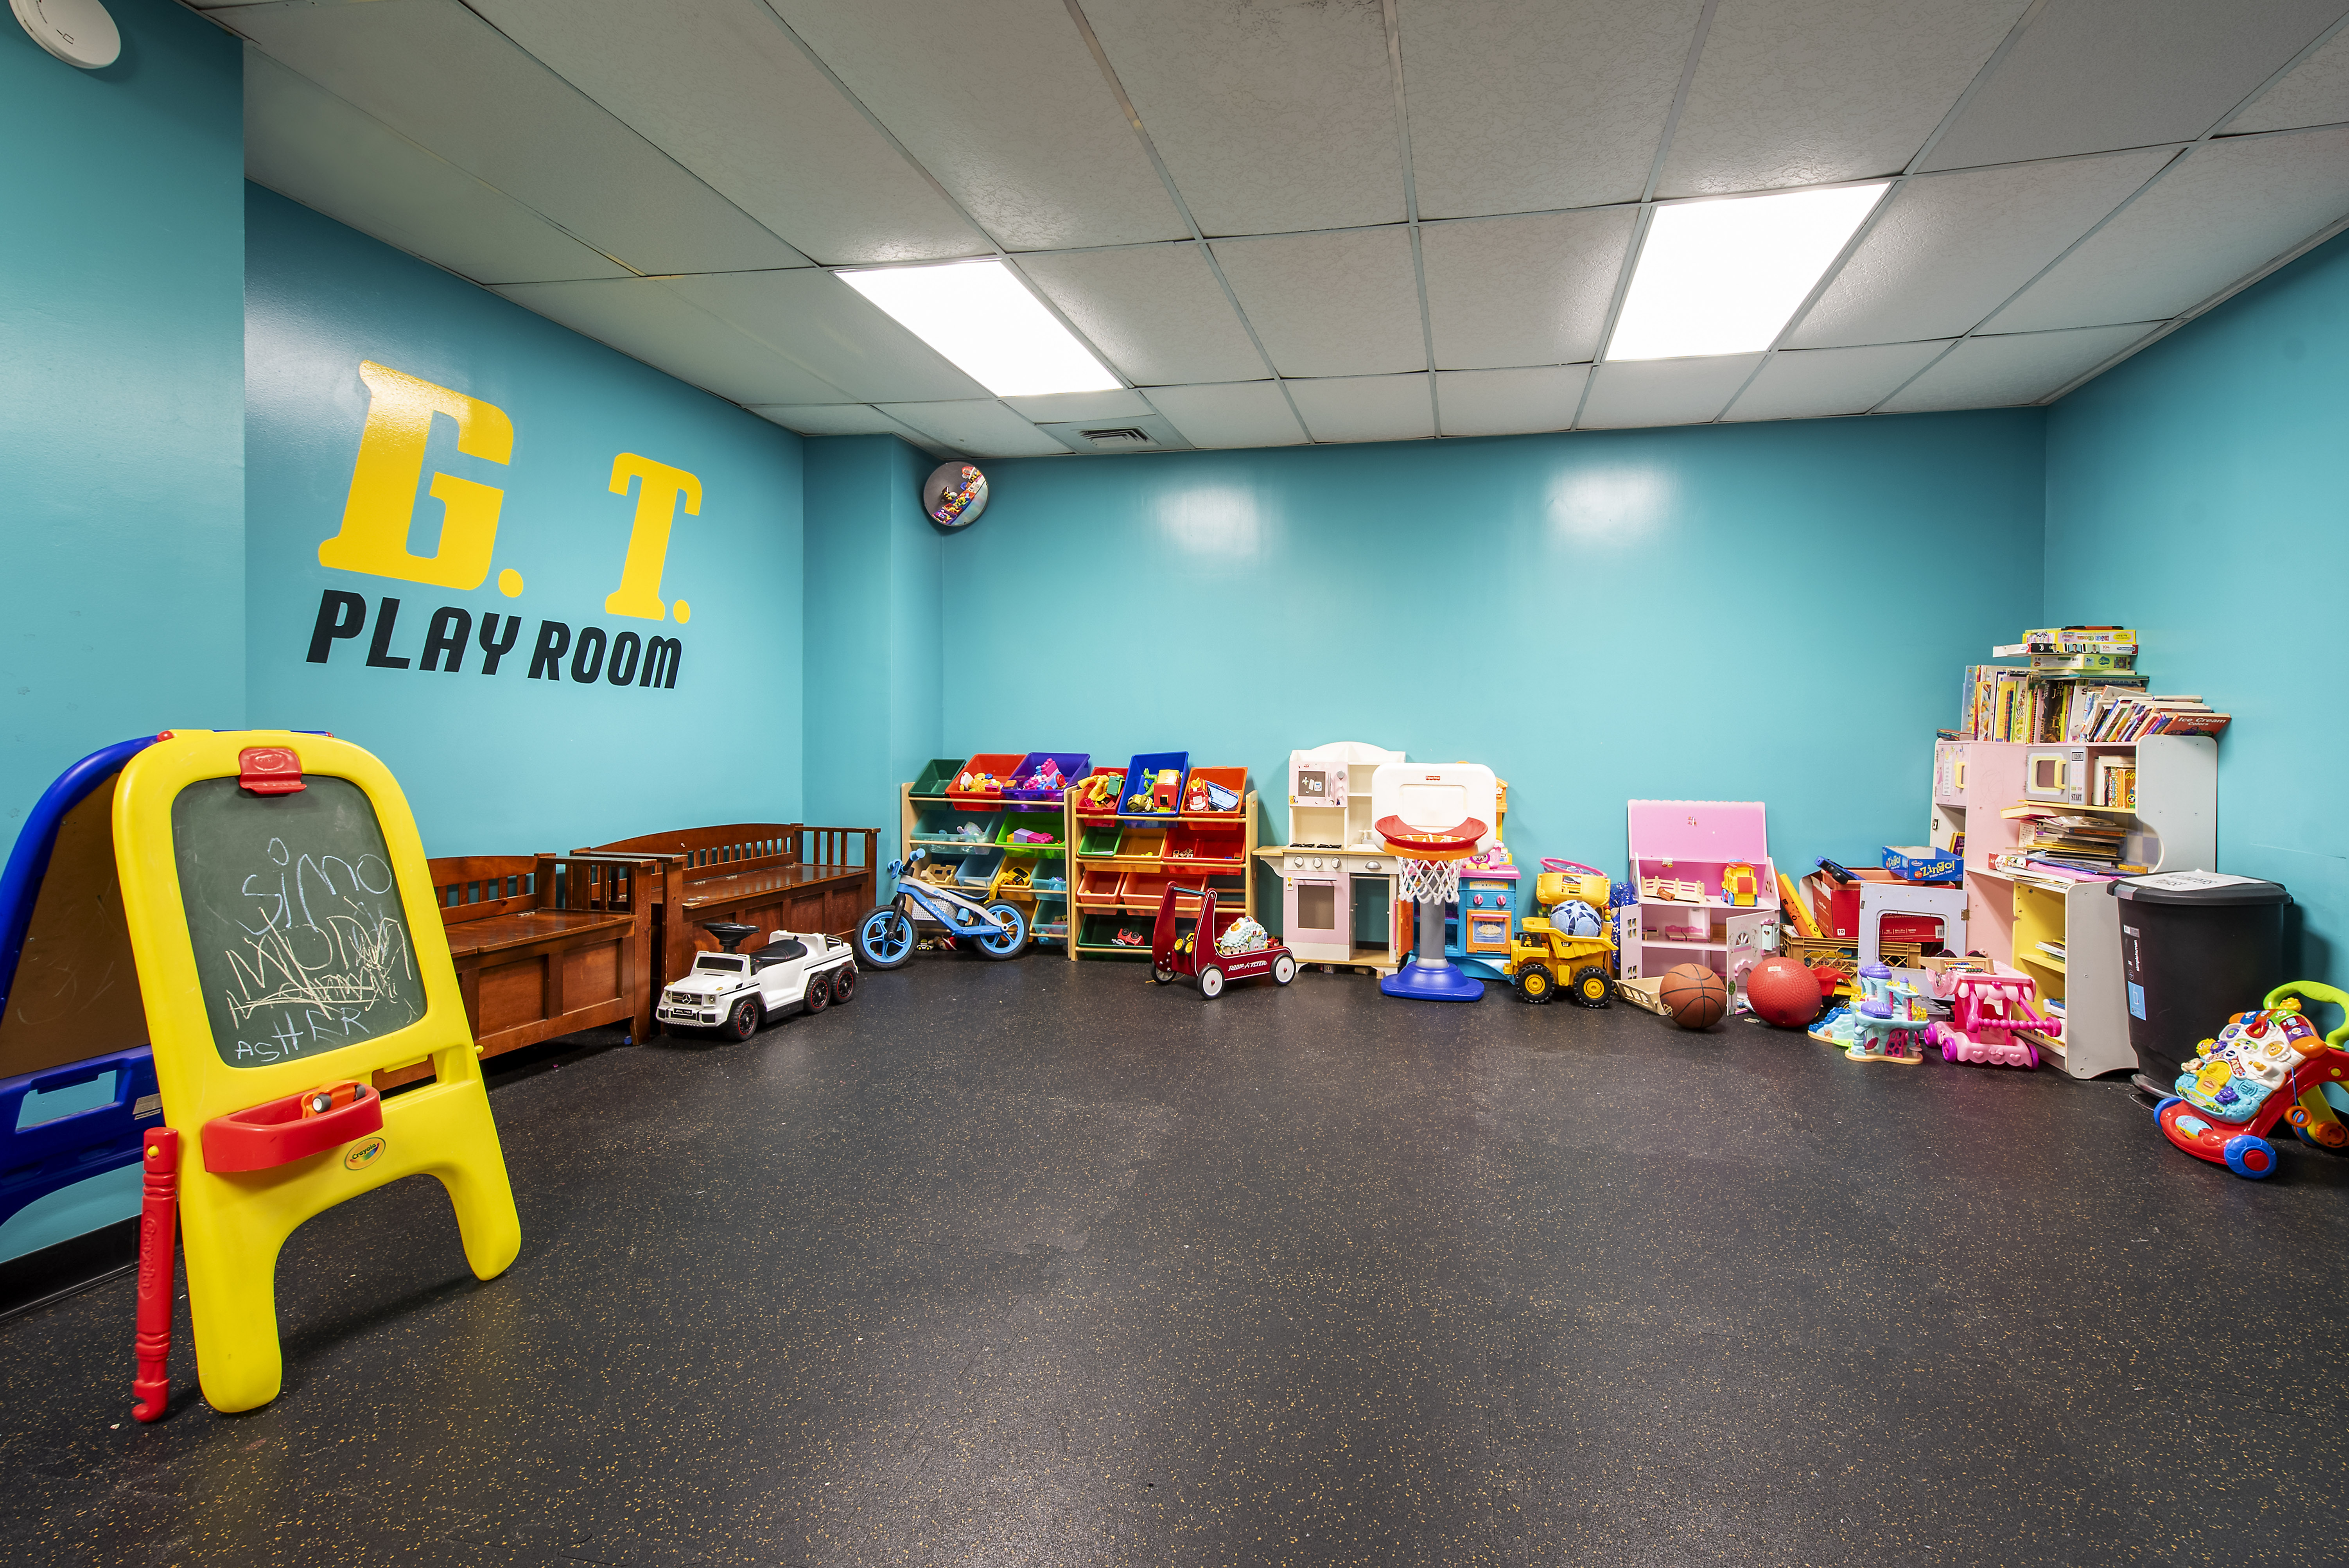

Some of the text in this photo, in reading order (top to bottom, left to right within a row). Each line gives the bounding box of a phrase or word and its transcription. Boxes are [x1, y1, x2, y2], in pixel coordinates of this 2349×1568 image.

[605, 452, 691, 624] T.
[306, 589, 682, 689] PLAY ROOM
[1920, 860, 1955, 877] Zingo!
[1228, 963, 1245, 972] RADIO
[235, 1007, 370, 1062] ASHER
[352, 1143, 377, 1160] Crayola
[142, 1217, 158, 1289] Crayola
